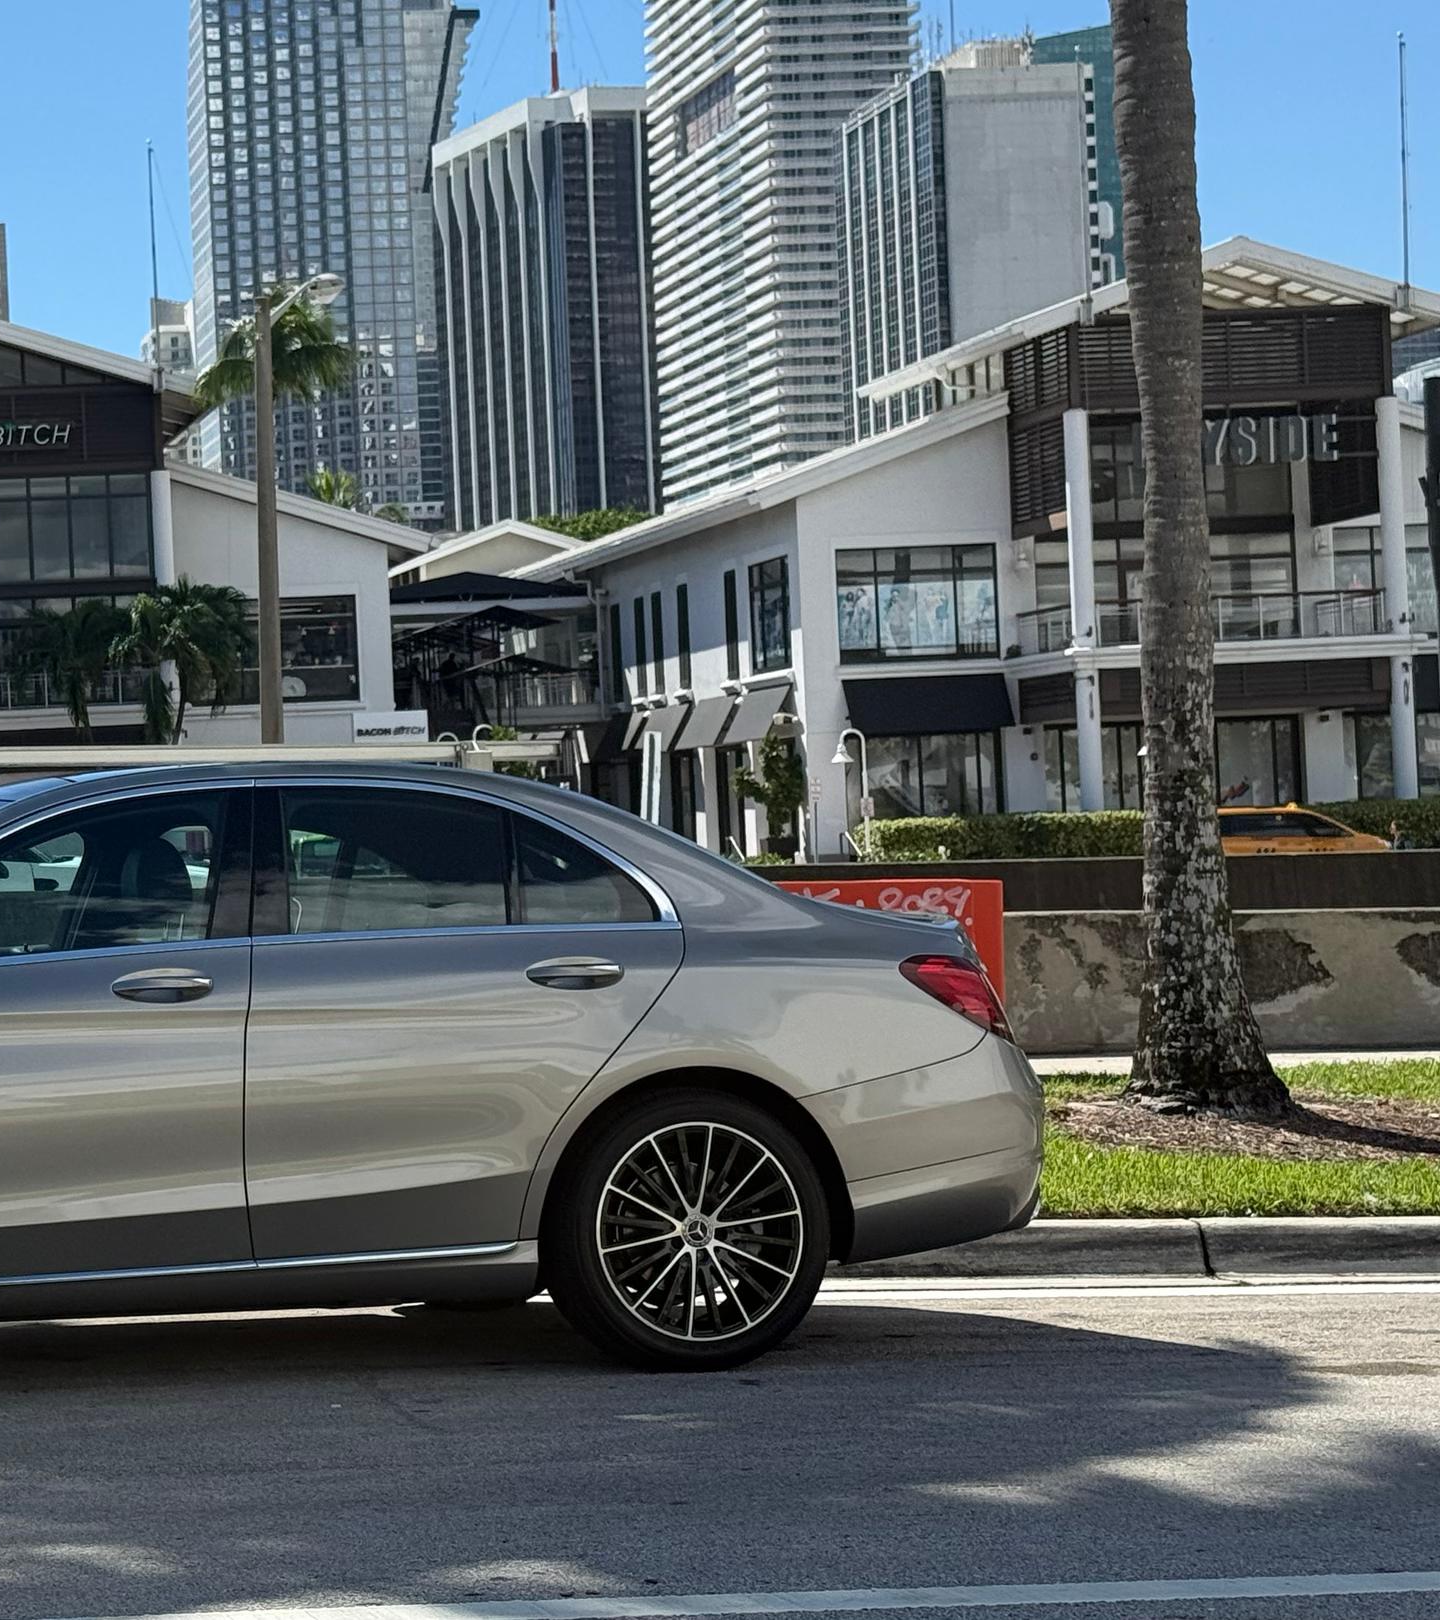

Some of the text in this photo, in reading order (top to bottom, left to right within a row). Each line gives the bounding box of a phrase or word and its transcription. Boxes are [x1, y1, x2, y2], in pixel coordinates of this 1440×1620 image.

[1133, 413, 1339, 466] YSIDE
[356, 725, 426, 737] BACON BITCH
